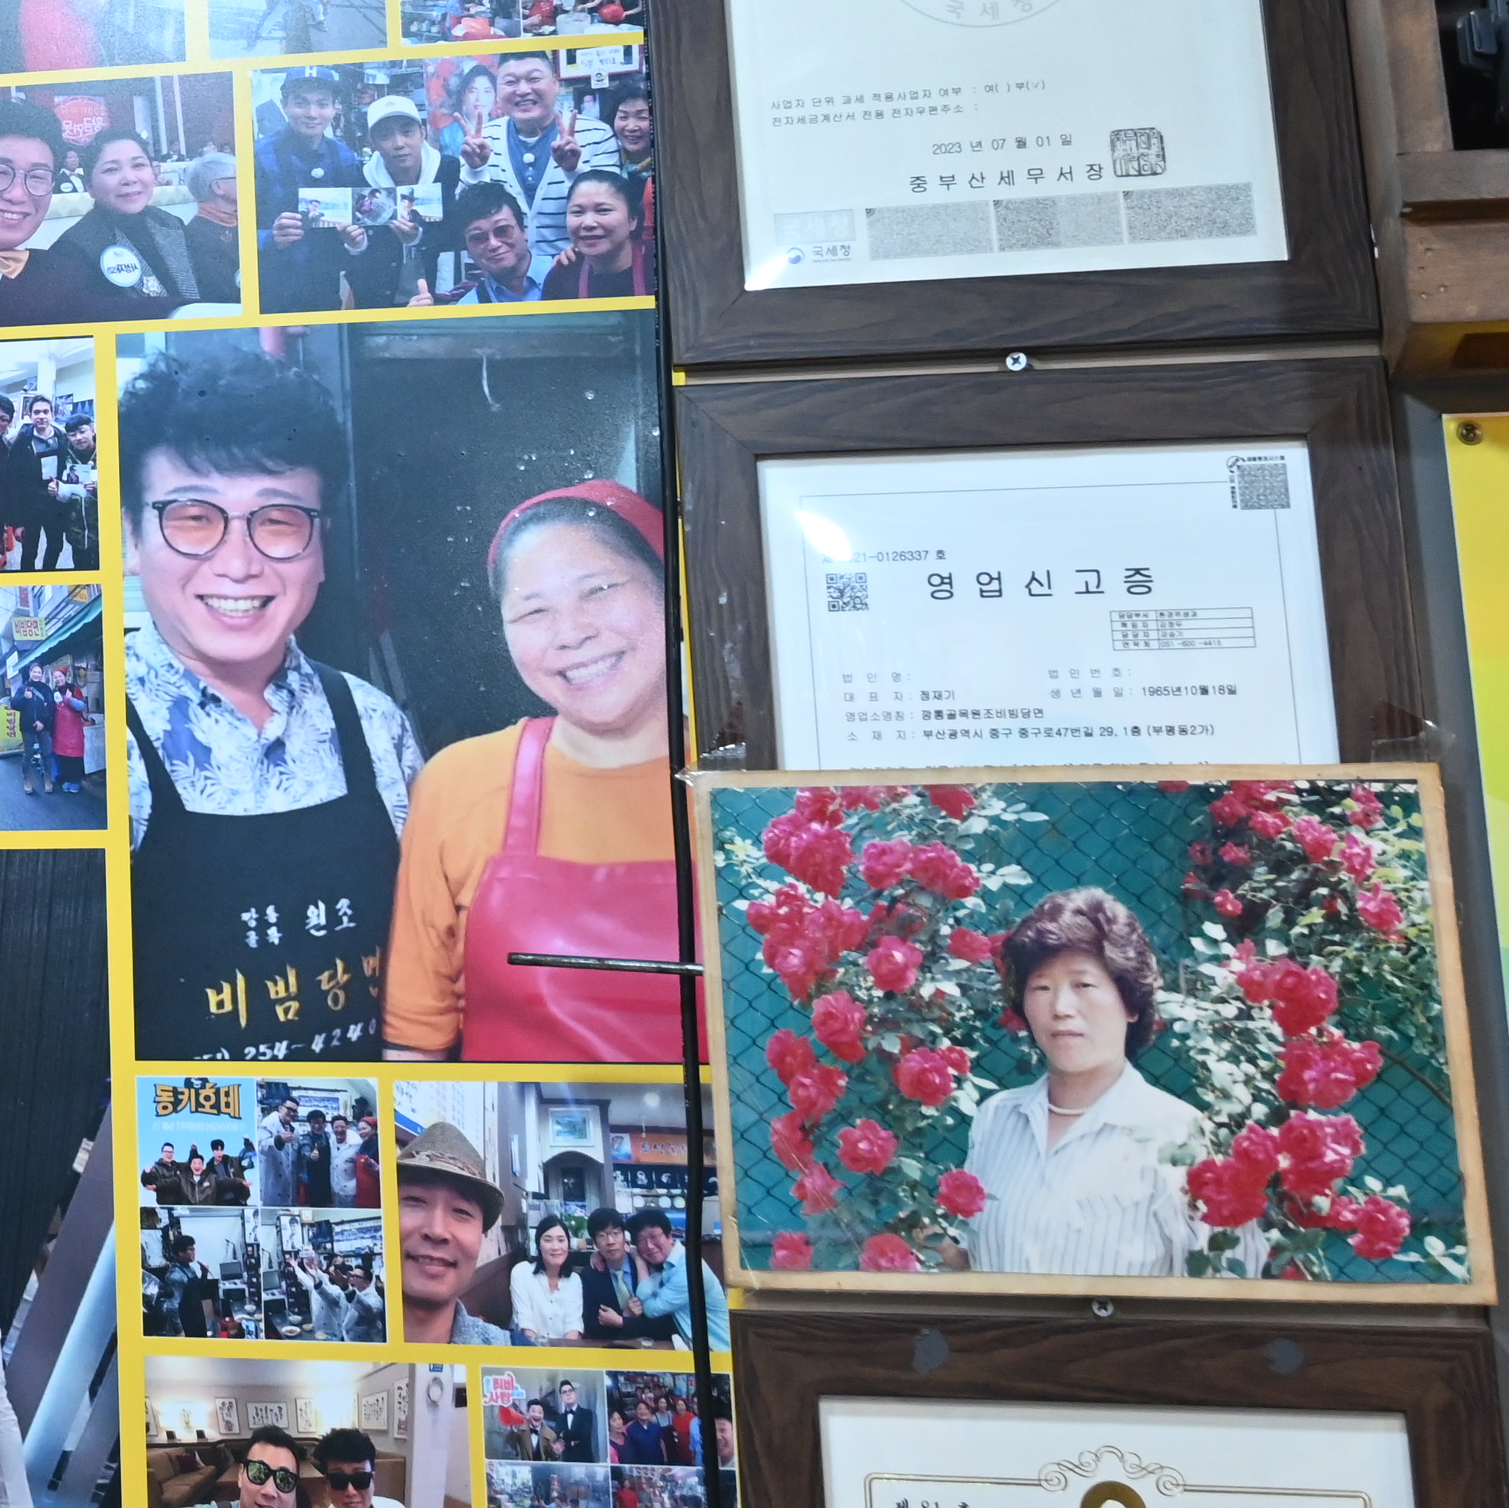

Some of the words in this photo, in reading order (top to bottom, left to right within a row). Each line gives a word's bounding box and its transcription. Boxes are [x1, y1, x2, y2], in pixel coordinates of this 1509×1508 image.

[932, 142, 962, 155] 2023
[991, 138, 1006, 151] 07
[1036, 136, 1051, 147] 01
[927, 567, 1154, 600] 영업신고증
[1142, 684, 1237, 696] 1965년10월18일
[923, 729, 983, 740] 부산광역시
[989, 728, 1012, 739] 중구
[153, 1081, 242, 1120] 동키호테
